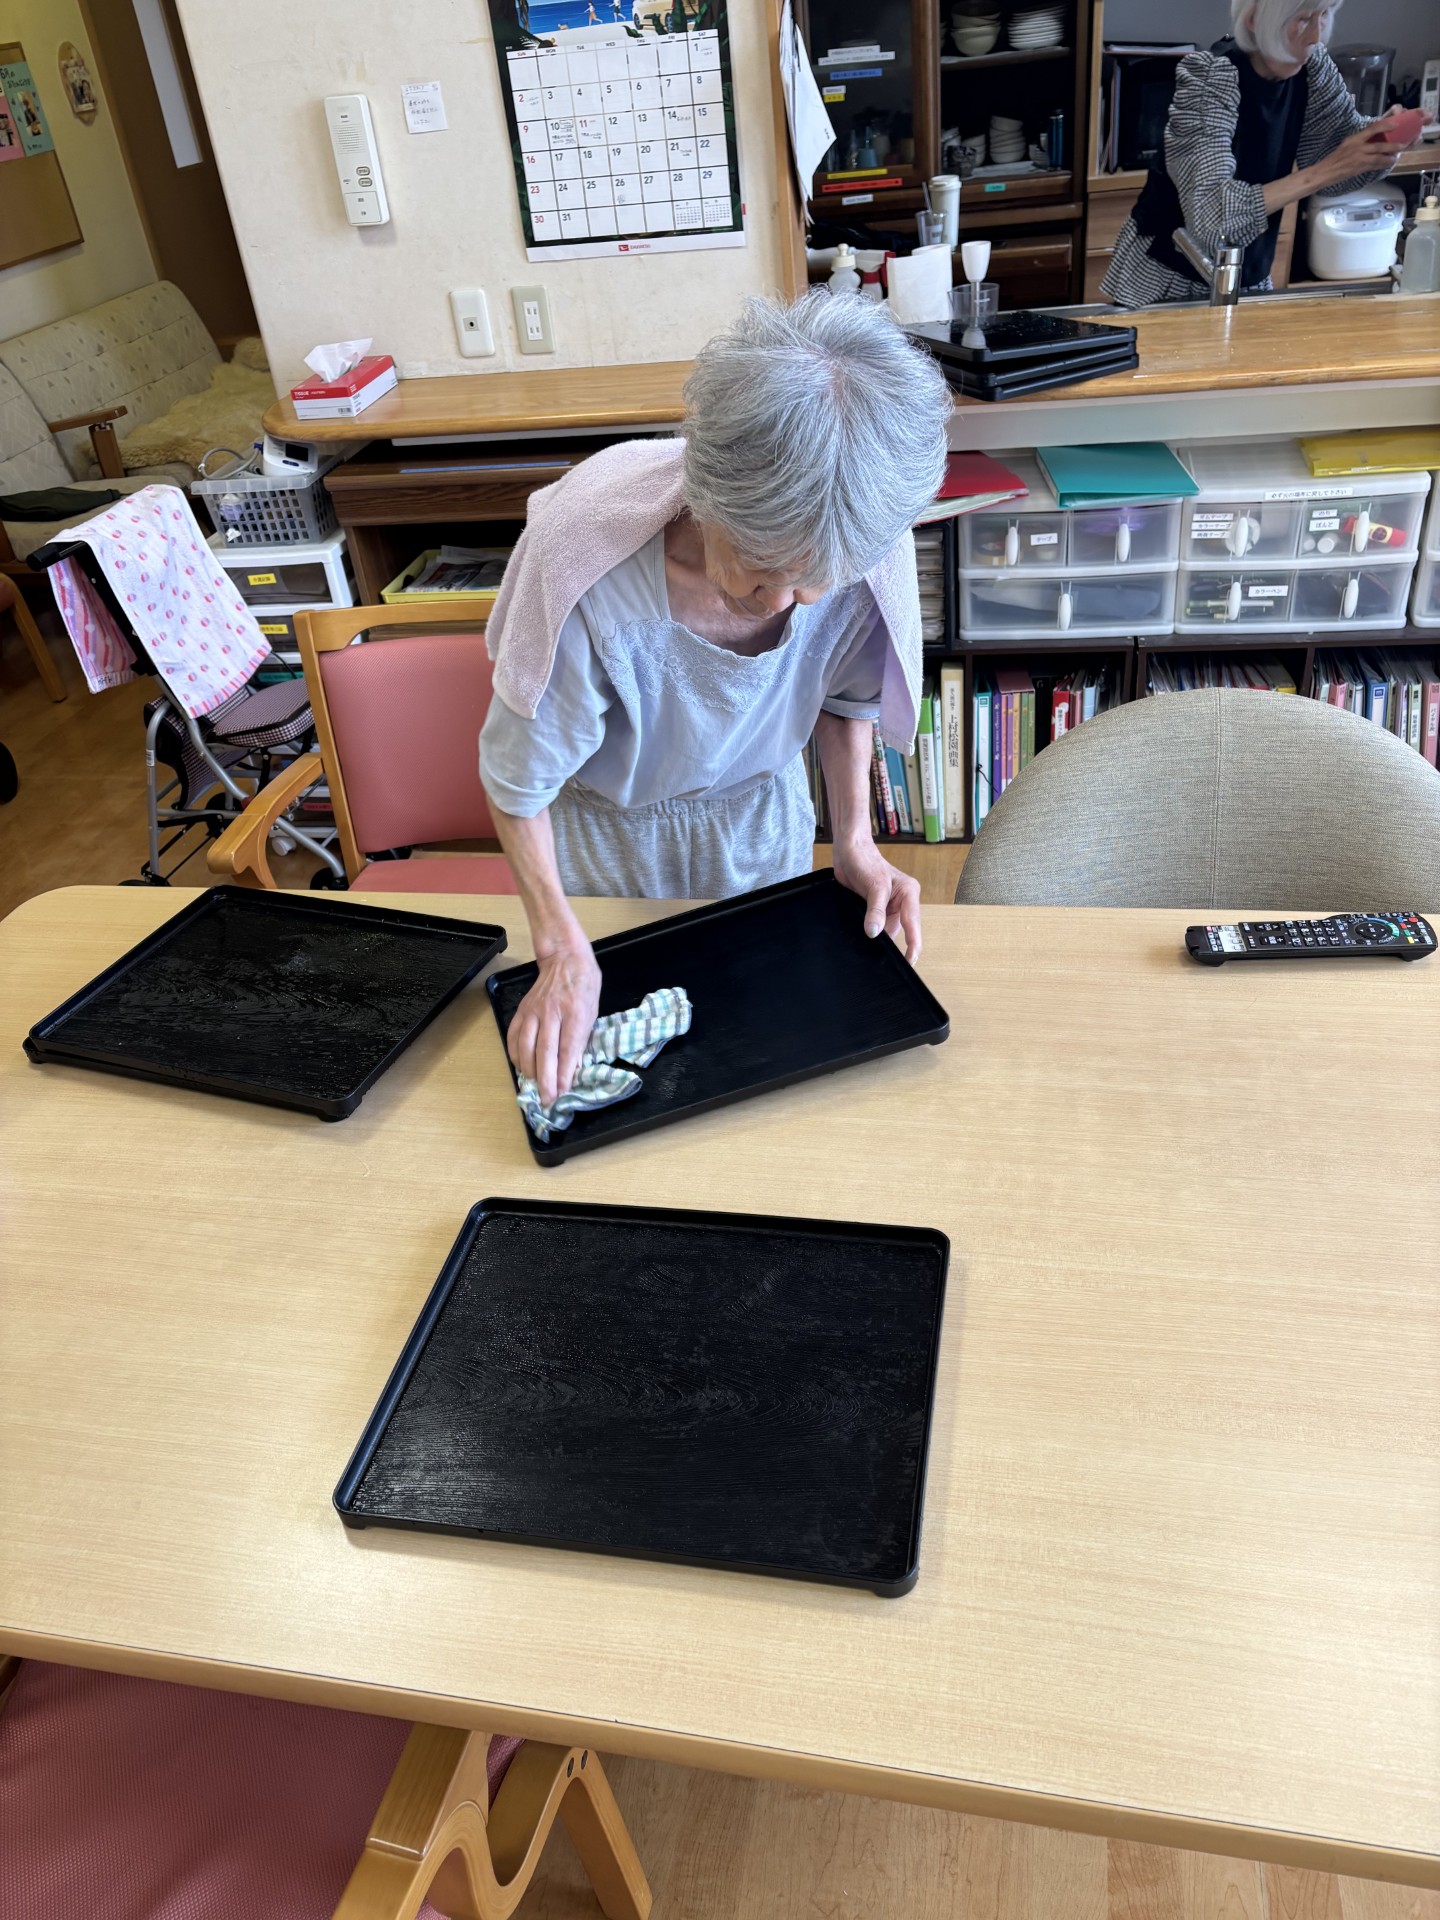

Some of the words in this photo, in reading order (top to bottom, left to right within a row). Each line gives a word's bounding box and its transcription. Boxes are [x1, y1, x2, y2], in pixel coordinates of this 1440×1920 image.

[694, 43, 699, 52] 1
[518, 94, 524, 103] 2
[547, 91, 554, 99] 3
[576, 88, 583, 96] 4
[606, 85, 612, 94] 5
[636, 82, 642, 90] 6
[666, 79, 672, 87] 7
[696, 76, 703, 84] 8
[523, 125, 529, 133] 9
[550, 122, 560, 131] 10
[579, 120, 588, 128] 11
[608, 117, 618, 125] 12
[638, 114, 647, 122] 13
[668, 111, 677, 119] 14
[698, 107, 707, 116] 15
[526, 156, 536, 164] 16
[555, 153, 564, 161] 17
[583, 150, 592, 159] 18
[612, 148, 621, 156] 19
[640, 145, 651, 154] 20
[670, 142, 680, 151] 21
[700, 139, 710, 148] 22
[530, 186, 540, 194] 23
[558, 183, 568, 191] 24
[586, 181, 596, 189] 25
[615, 178, 625, 187] 26
[644, 176, 653, 184] 27
[673, 173, 683, 181] 28
[702, 171, 712, 179] 29
[534, 215, 544, 223] 30
[562, 213, 571, 221] 31
